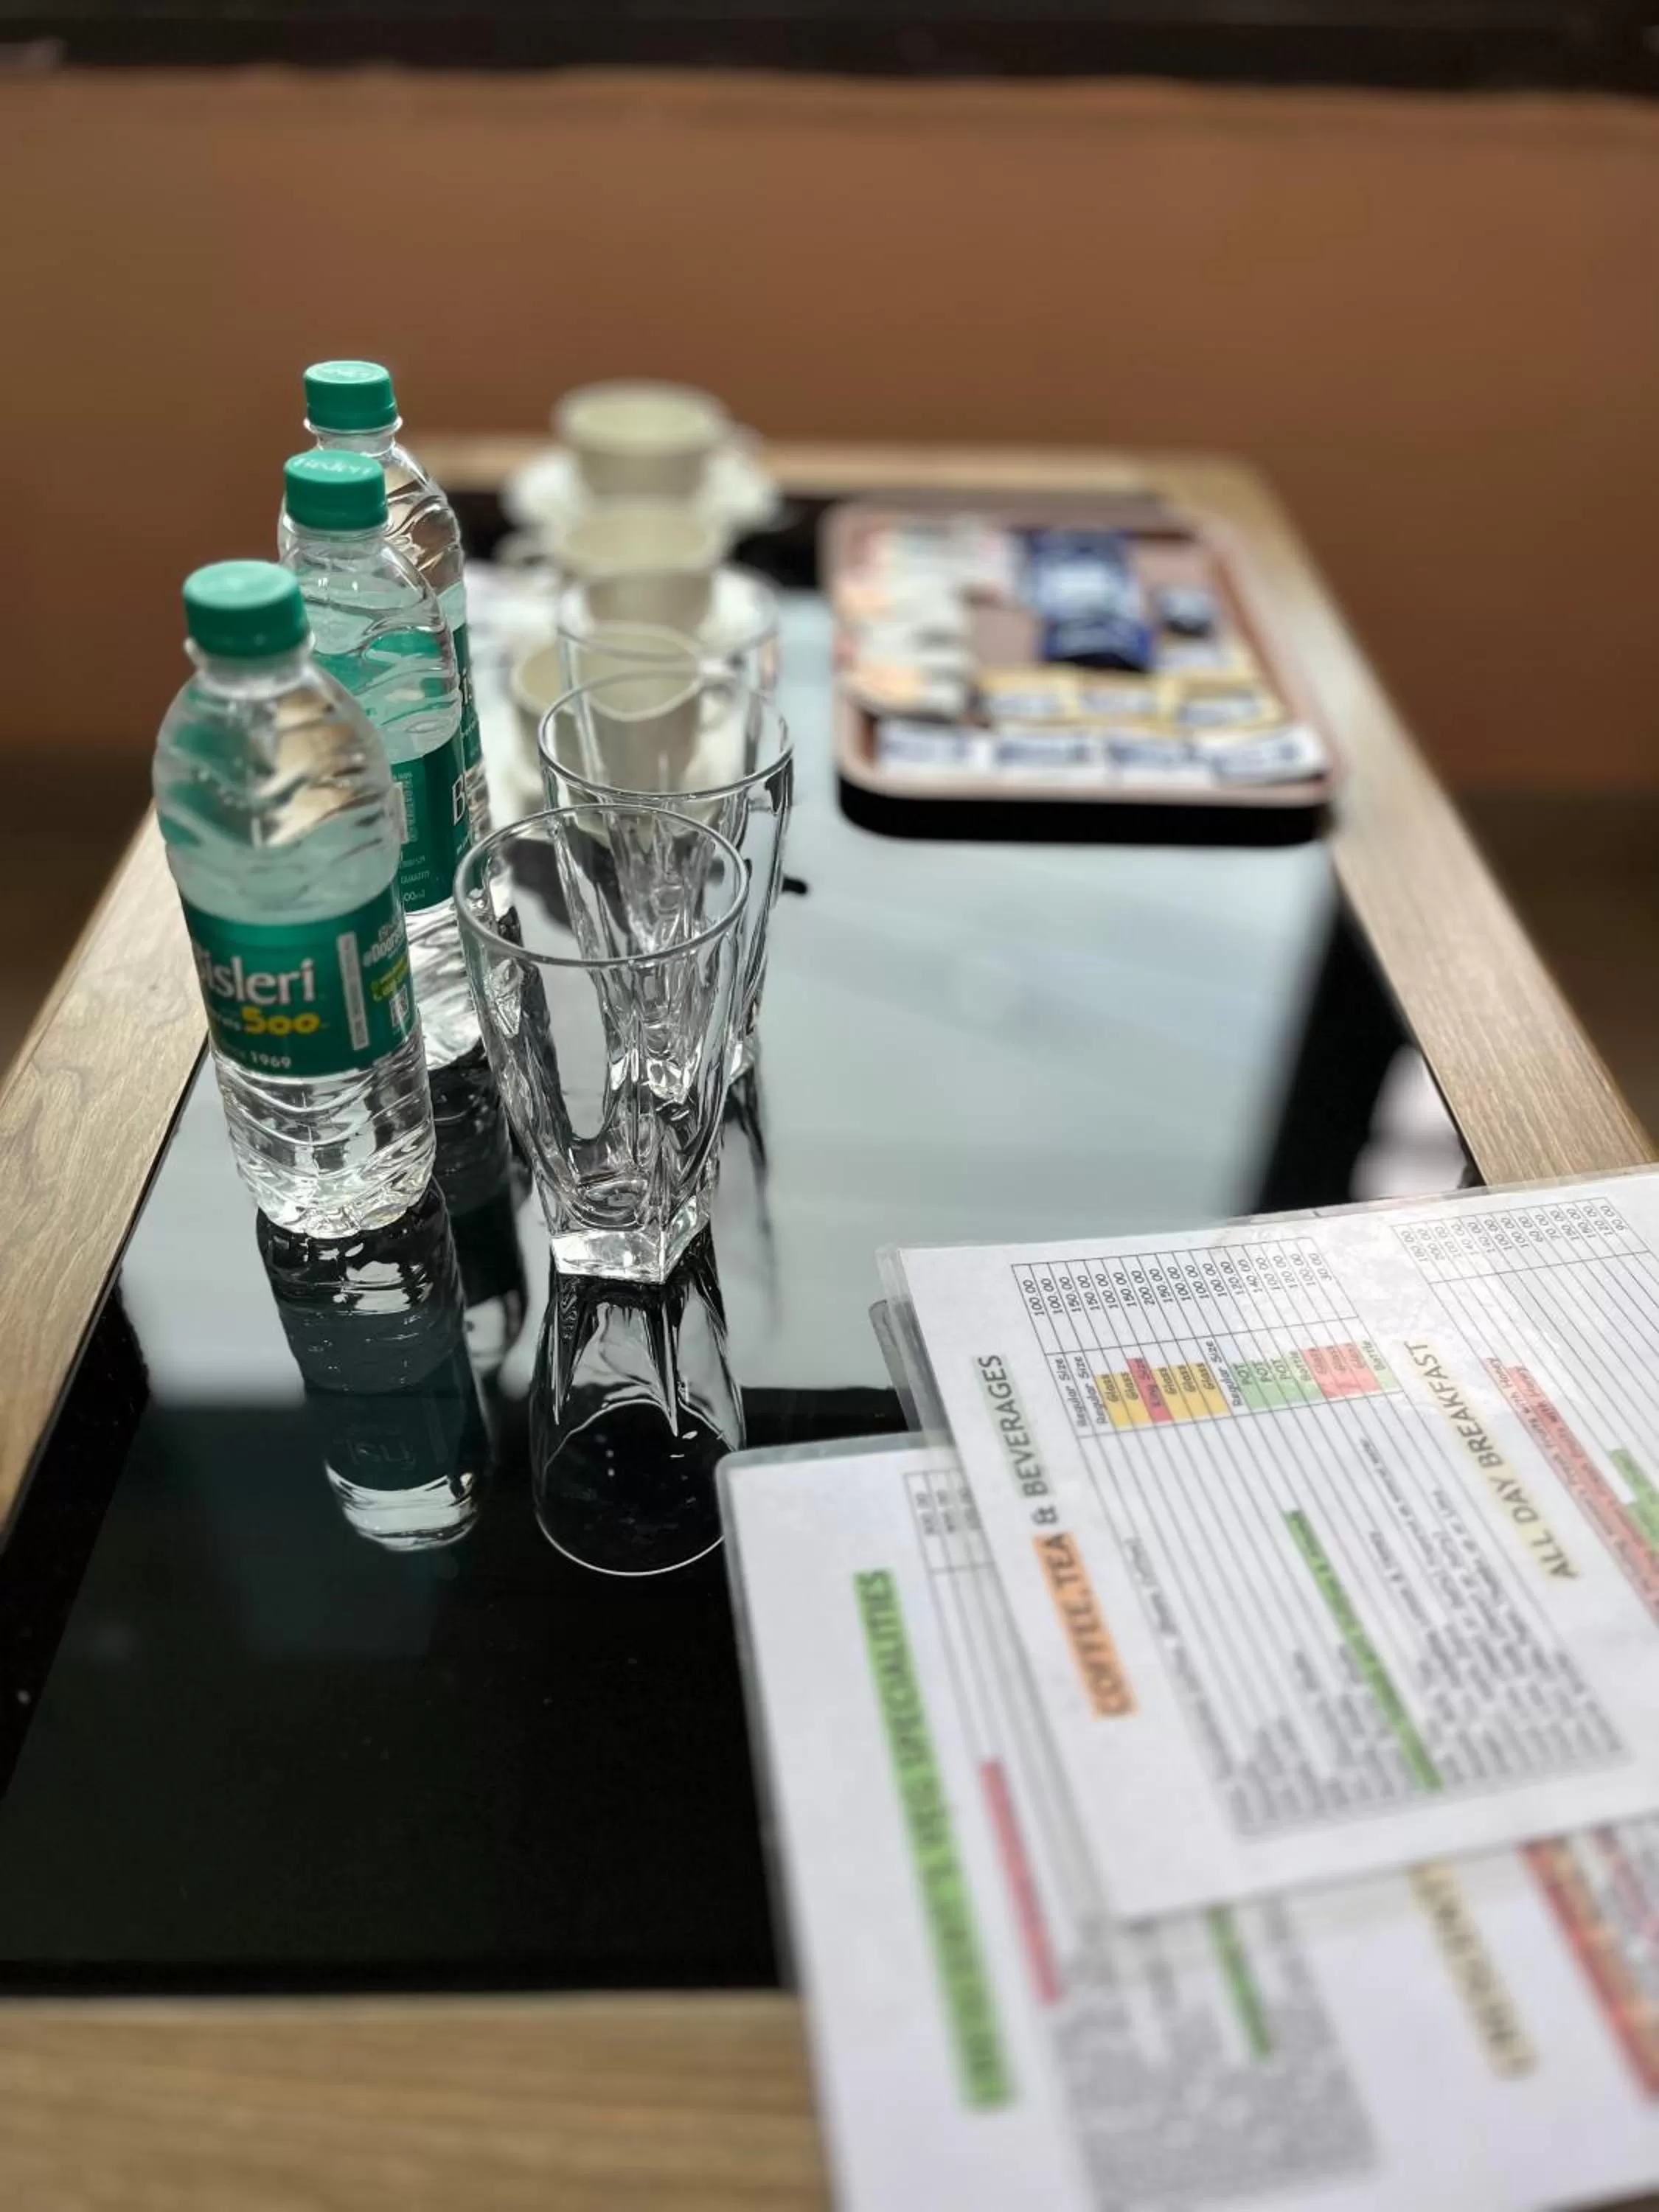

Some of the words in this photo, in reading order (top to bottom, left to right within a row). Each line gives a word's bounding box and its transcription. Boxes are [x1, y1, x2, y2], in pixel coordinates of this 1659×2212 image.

[240, 1005, 321, 1037] 500
[250, 1050, 291, 1068] 1969
[1481, 1219, 1514, 1250] 100.00
[1497, 1217, 1531, 1248] 100.00
[1093, 1273, 1119, 1309] 100.00
[1111, 1271, 1138, 1307] 150.00
[1129, 1270, 1156, 1305] 200.00
[1147, 1267, 1174, 1304] 150.00
[1164, 1266, 1192, 1301] 100.00
[1183, 1265, 1211, 1298] 100.00
[1200, 1262, 1228, 1297] 100.00
[1218, 1261, 1246, 1295] 120.00
[1236, 1258, 1265, 1293] 140.00
[1020, 1279, 1046, 1316] 100.00
[1039, 1277, 1065, 1314] 100.00
[1057, 1276, 1083, 1312] 150.00
[1075, 1275, 1102, 1311] 150.00
[1071, 1355, 1091, 1379] Size
[1200, 1340, 1222, 1363] Size
[1052, 1357, 1071, 1381] Size
[1155, 1366, 1178, 1395] Glass
[1174, 1364, 1198, 1393] Glass
[1192, 1362, 1217, 1391] Glass
[1232, 1362, 1255, 1385] POT
[1251, 1360, 1273, 1382] POT
[1269, 1357, 1292, 1380] POT
[1483, 1356, 1517, 1388] Honey
[1508, 1364, 1545, 1397] Honey
[1097, 1373, 1121, 1403] Glass
[1117, 1371, 1141, 1400] Glass
[1214, 1366, 1248, 1407] Regular
[1507, 1391, 1531, 1413] with
[1063, 1384, 1093, 1427] Regular
[1082, 1382, 1112, 1425] Regular
[1401, 1339, 1506, 1468] BREAKFAST
[975, 1354, 1050, 1498] BEVERAGES
[1029, 1505, 1060, 1526] &
[1489, 1476, 1541, 1524] DAY
[1523, 1529, 1579, 1582] ALL
